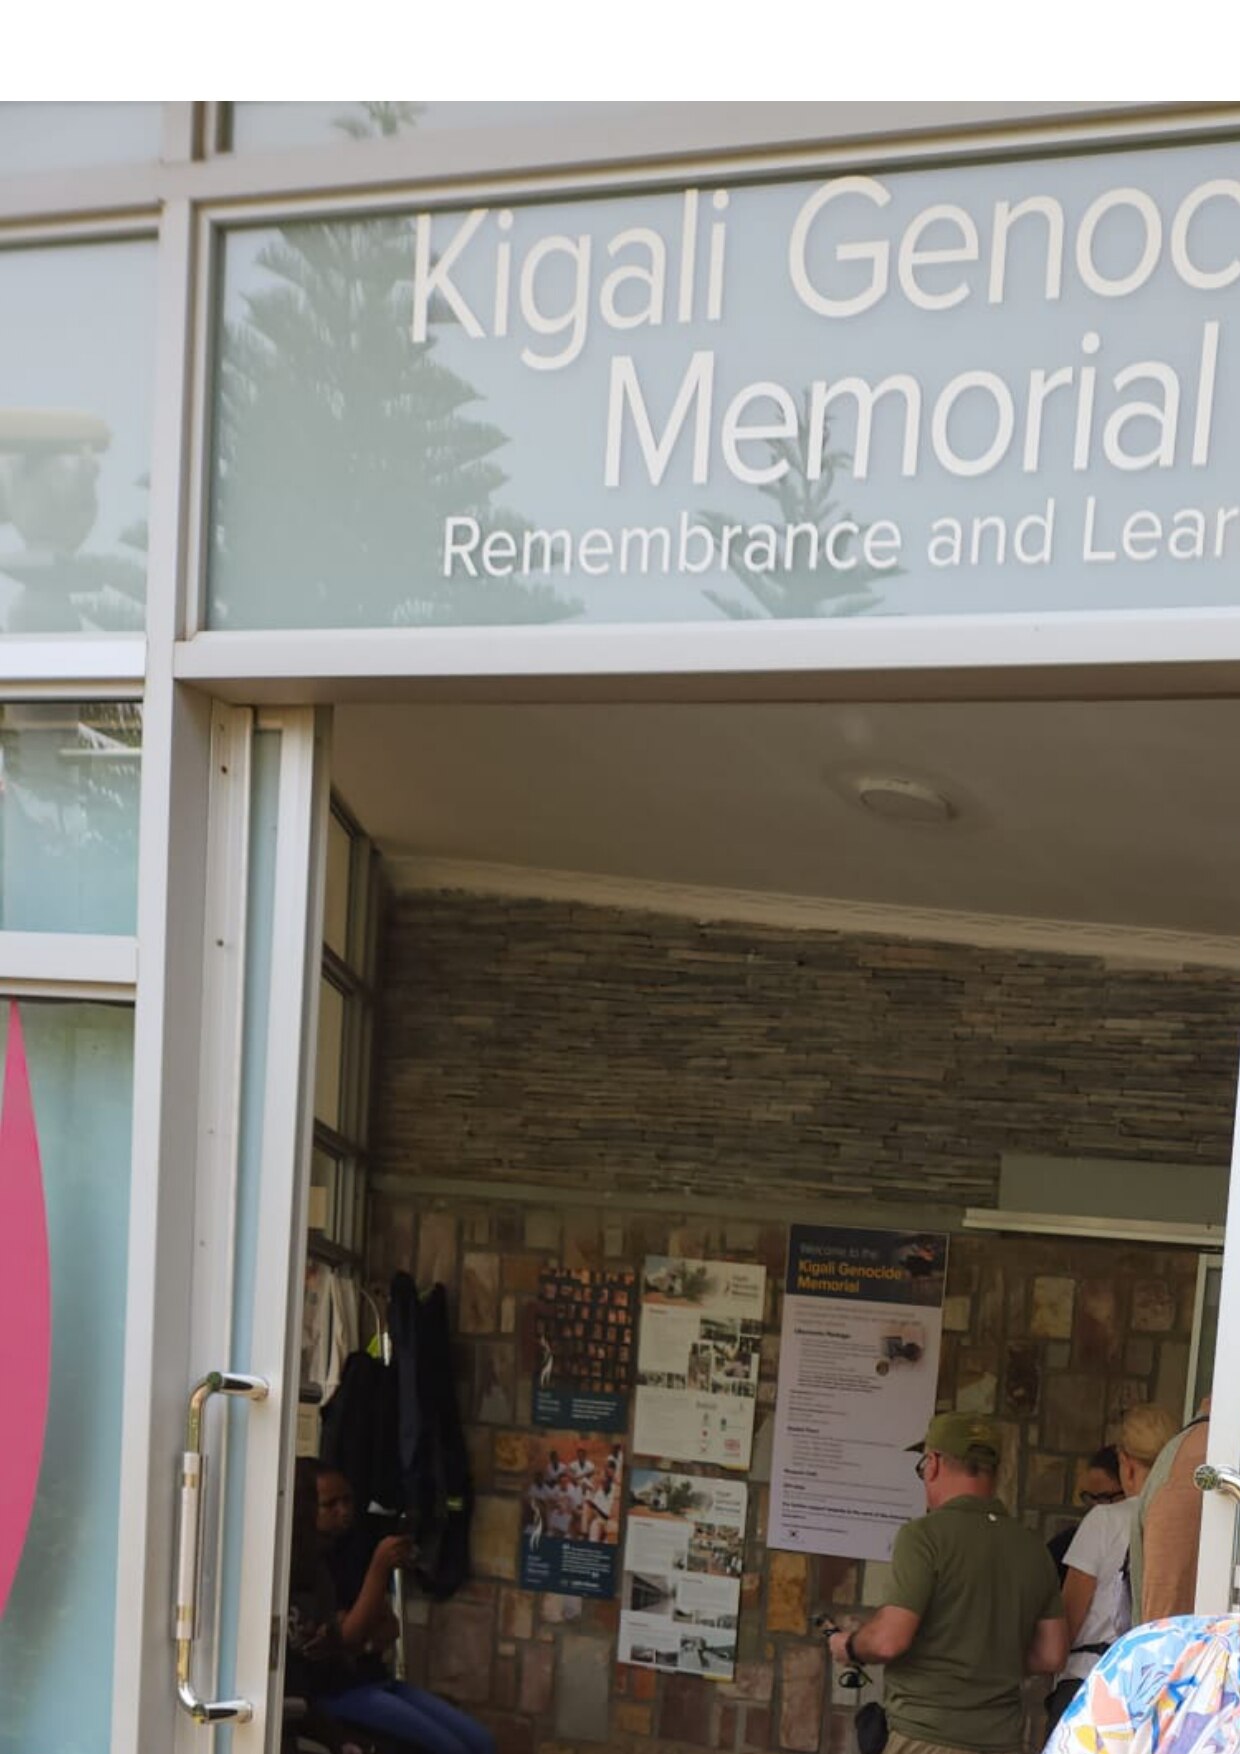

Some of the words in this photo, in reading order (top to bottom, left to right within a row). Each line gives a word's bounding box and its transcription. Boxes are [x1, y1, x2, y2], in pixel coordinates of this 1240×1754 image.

[410, 189, 729, 371] Kigali
[604, 321, 1220, 487] Memorial
[442, 510, 903, 577] Remembrance
[928, 497, 1056, 566] and
[797, 1276, 860, 1293] Memorial
[799, 1259, 835, 1276] Kigali
[838, 1261, 902, 1281] Genocide
